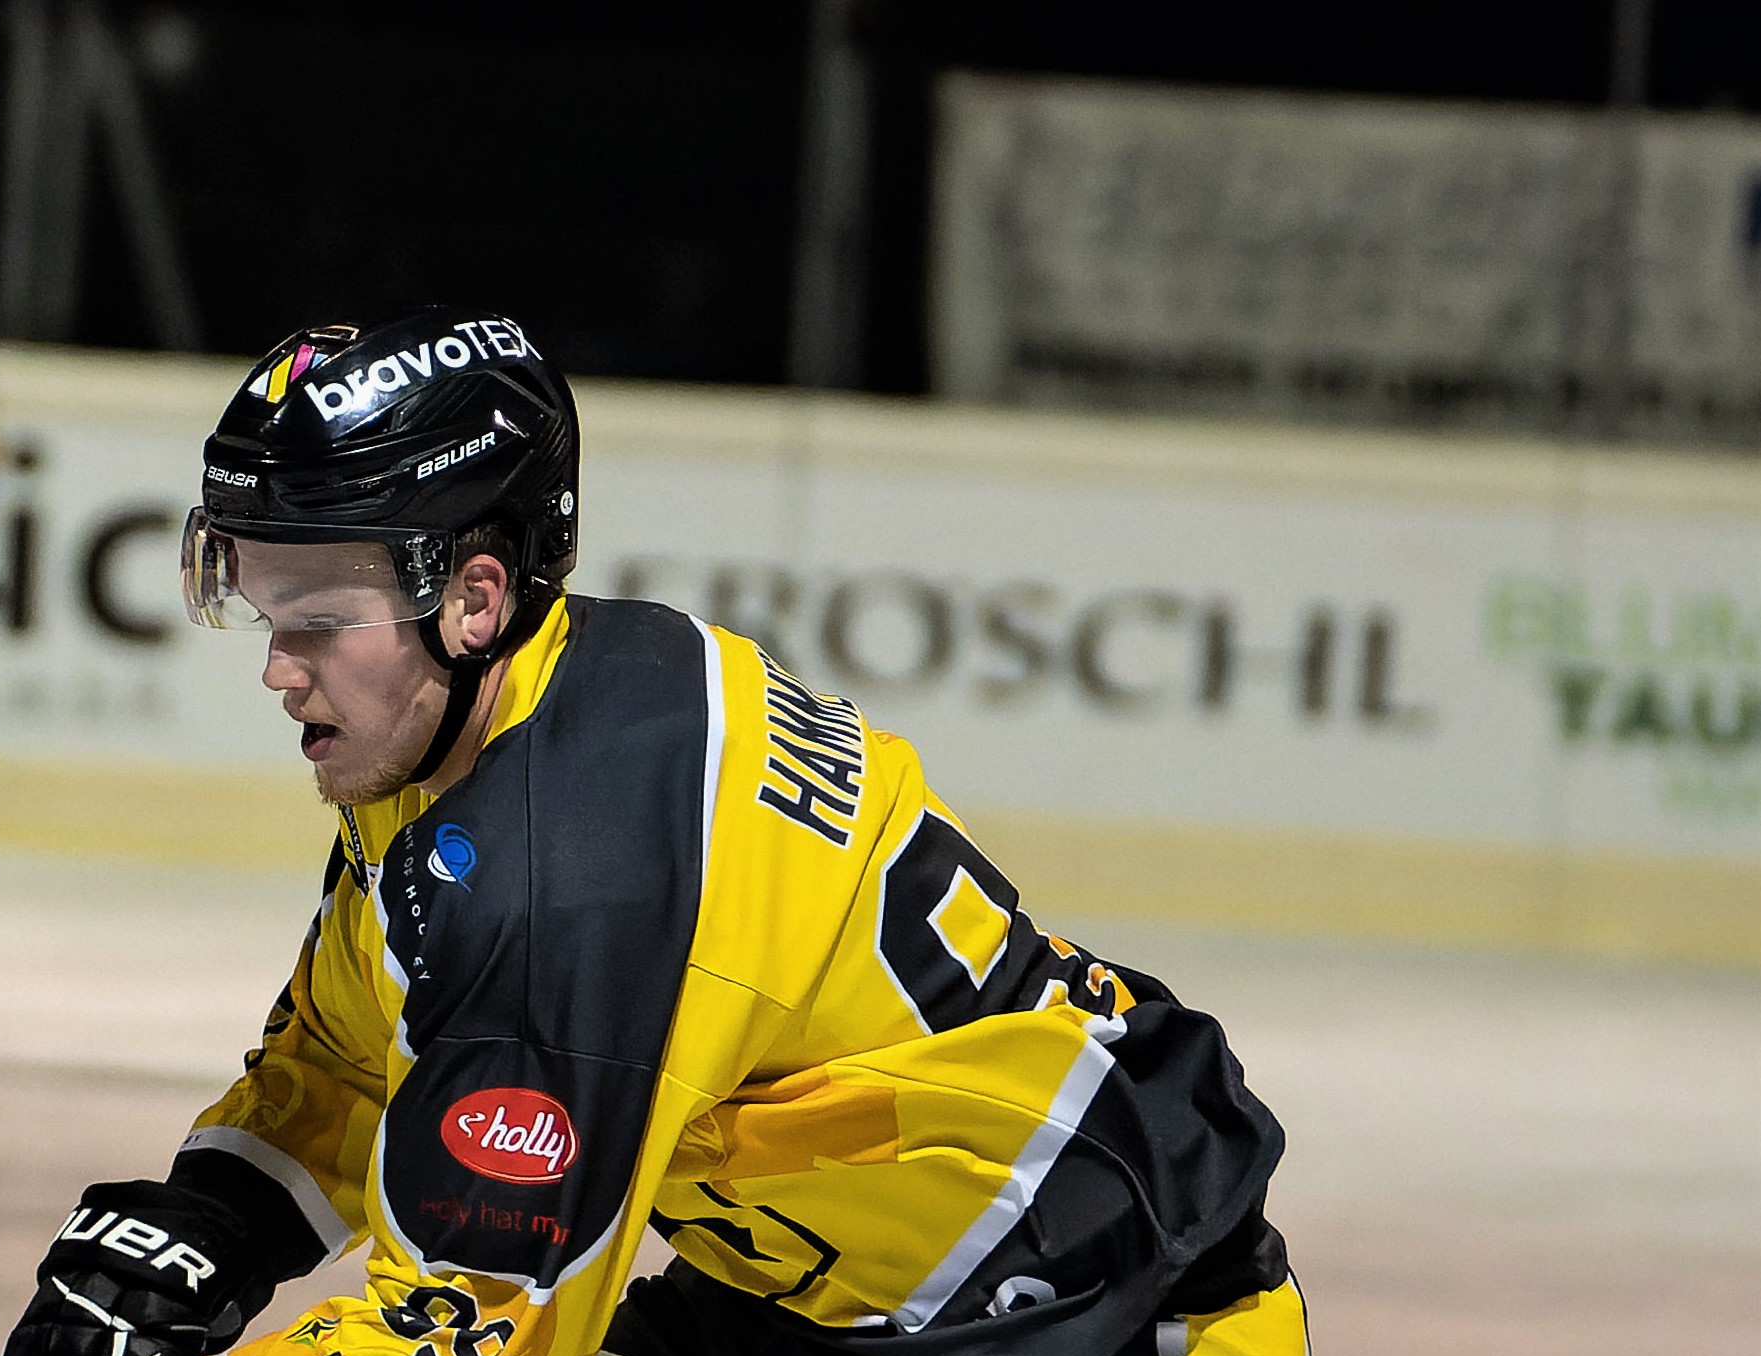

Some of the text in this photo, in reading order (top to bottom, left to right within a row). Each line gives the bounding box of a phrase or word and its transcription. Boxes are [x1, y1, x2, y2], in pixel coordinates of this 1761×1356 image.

[207, 465, 258, 489] BAUER
[416, 431, 496, 480] BAUER
[405, 885, 431, 980] HOCEY
[480, 1105, 566, 1173] holly
[54, 1208, 216, 1293] UER
